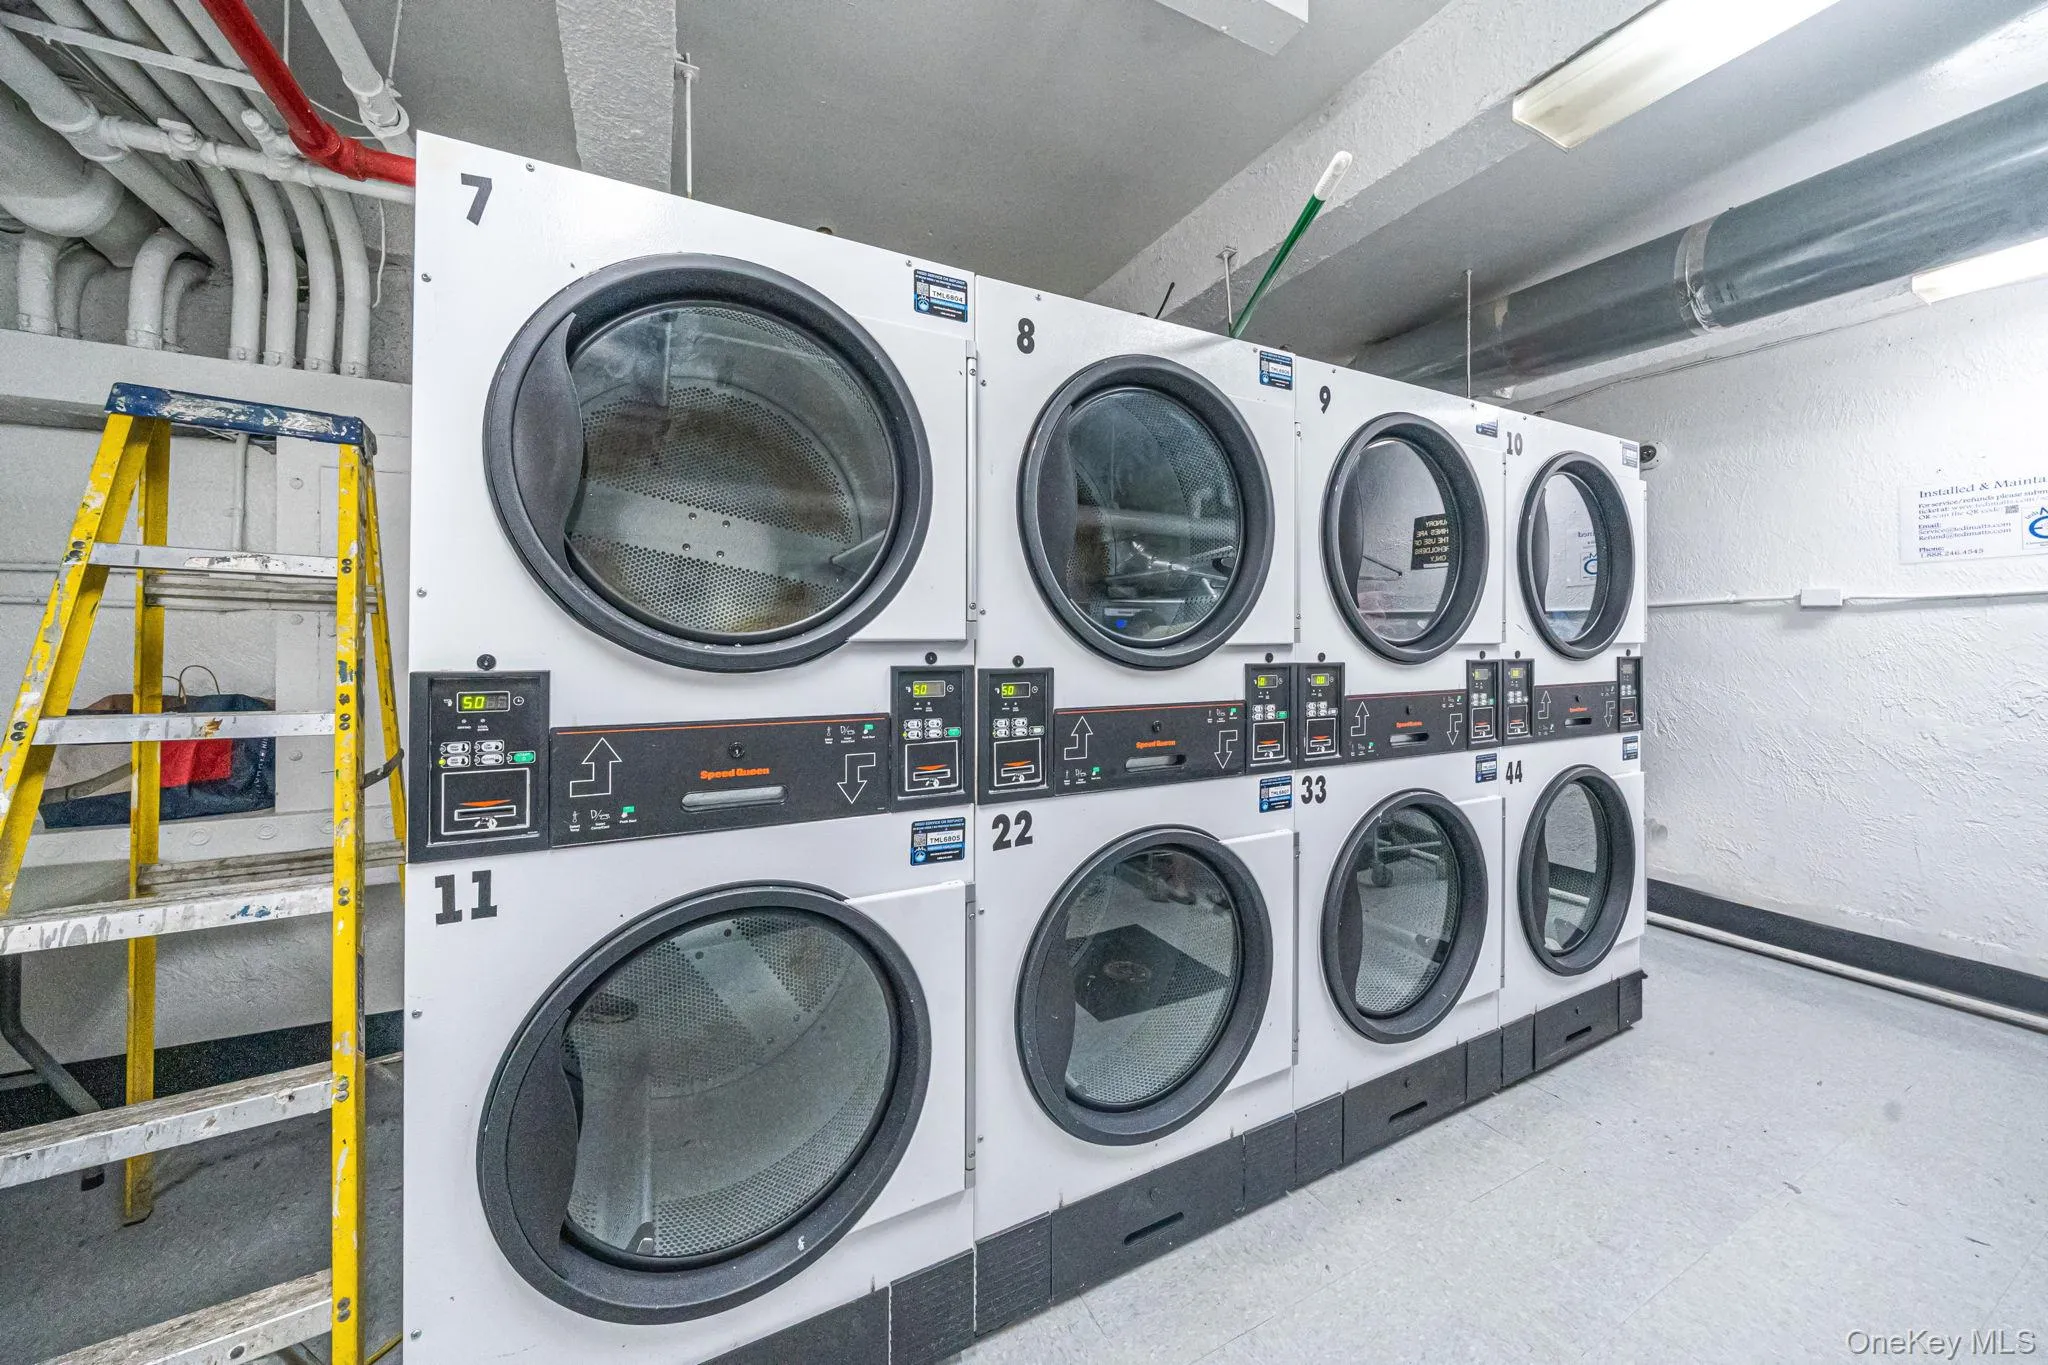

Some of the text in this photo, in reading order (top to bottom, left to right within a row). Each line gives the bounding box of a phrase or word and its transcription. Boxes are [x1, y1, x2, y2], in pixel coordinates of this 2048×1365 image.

[461, 172, 493, 226] 7
[932, 290, 963, 302] TML6804
[1016, 317, 1035, 354] 8
[1319, 385, 1331, 414] 9
[1506, 431, 1523, 456] 10
[1919, 484, 1975, 498] Installed
[1979, 482, 1989, 491] &
[913, 684, 928, 695] 50
[1001, 685, 1015, 696] 50
[462, 696, 485, 709] 50
[700, 767, 770, 780] Speed Queen
[1505, 760, 1523, 785] 44
[1301, 775, 1326, 804] 33
[929, 835, 961, 844] TML6805
[991, 810, 1033, 852] 22
[435, 869, 498, 925] 11
